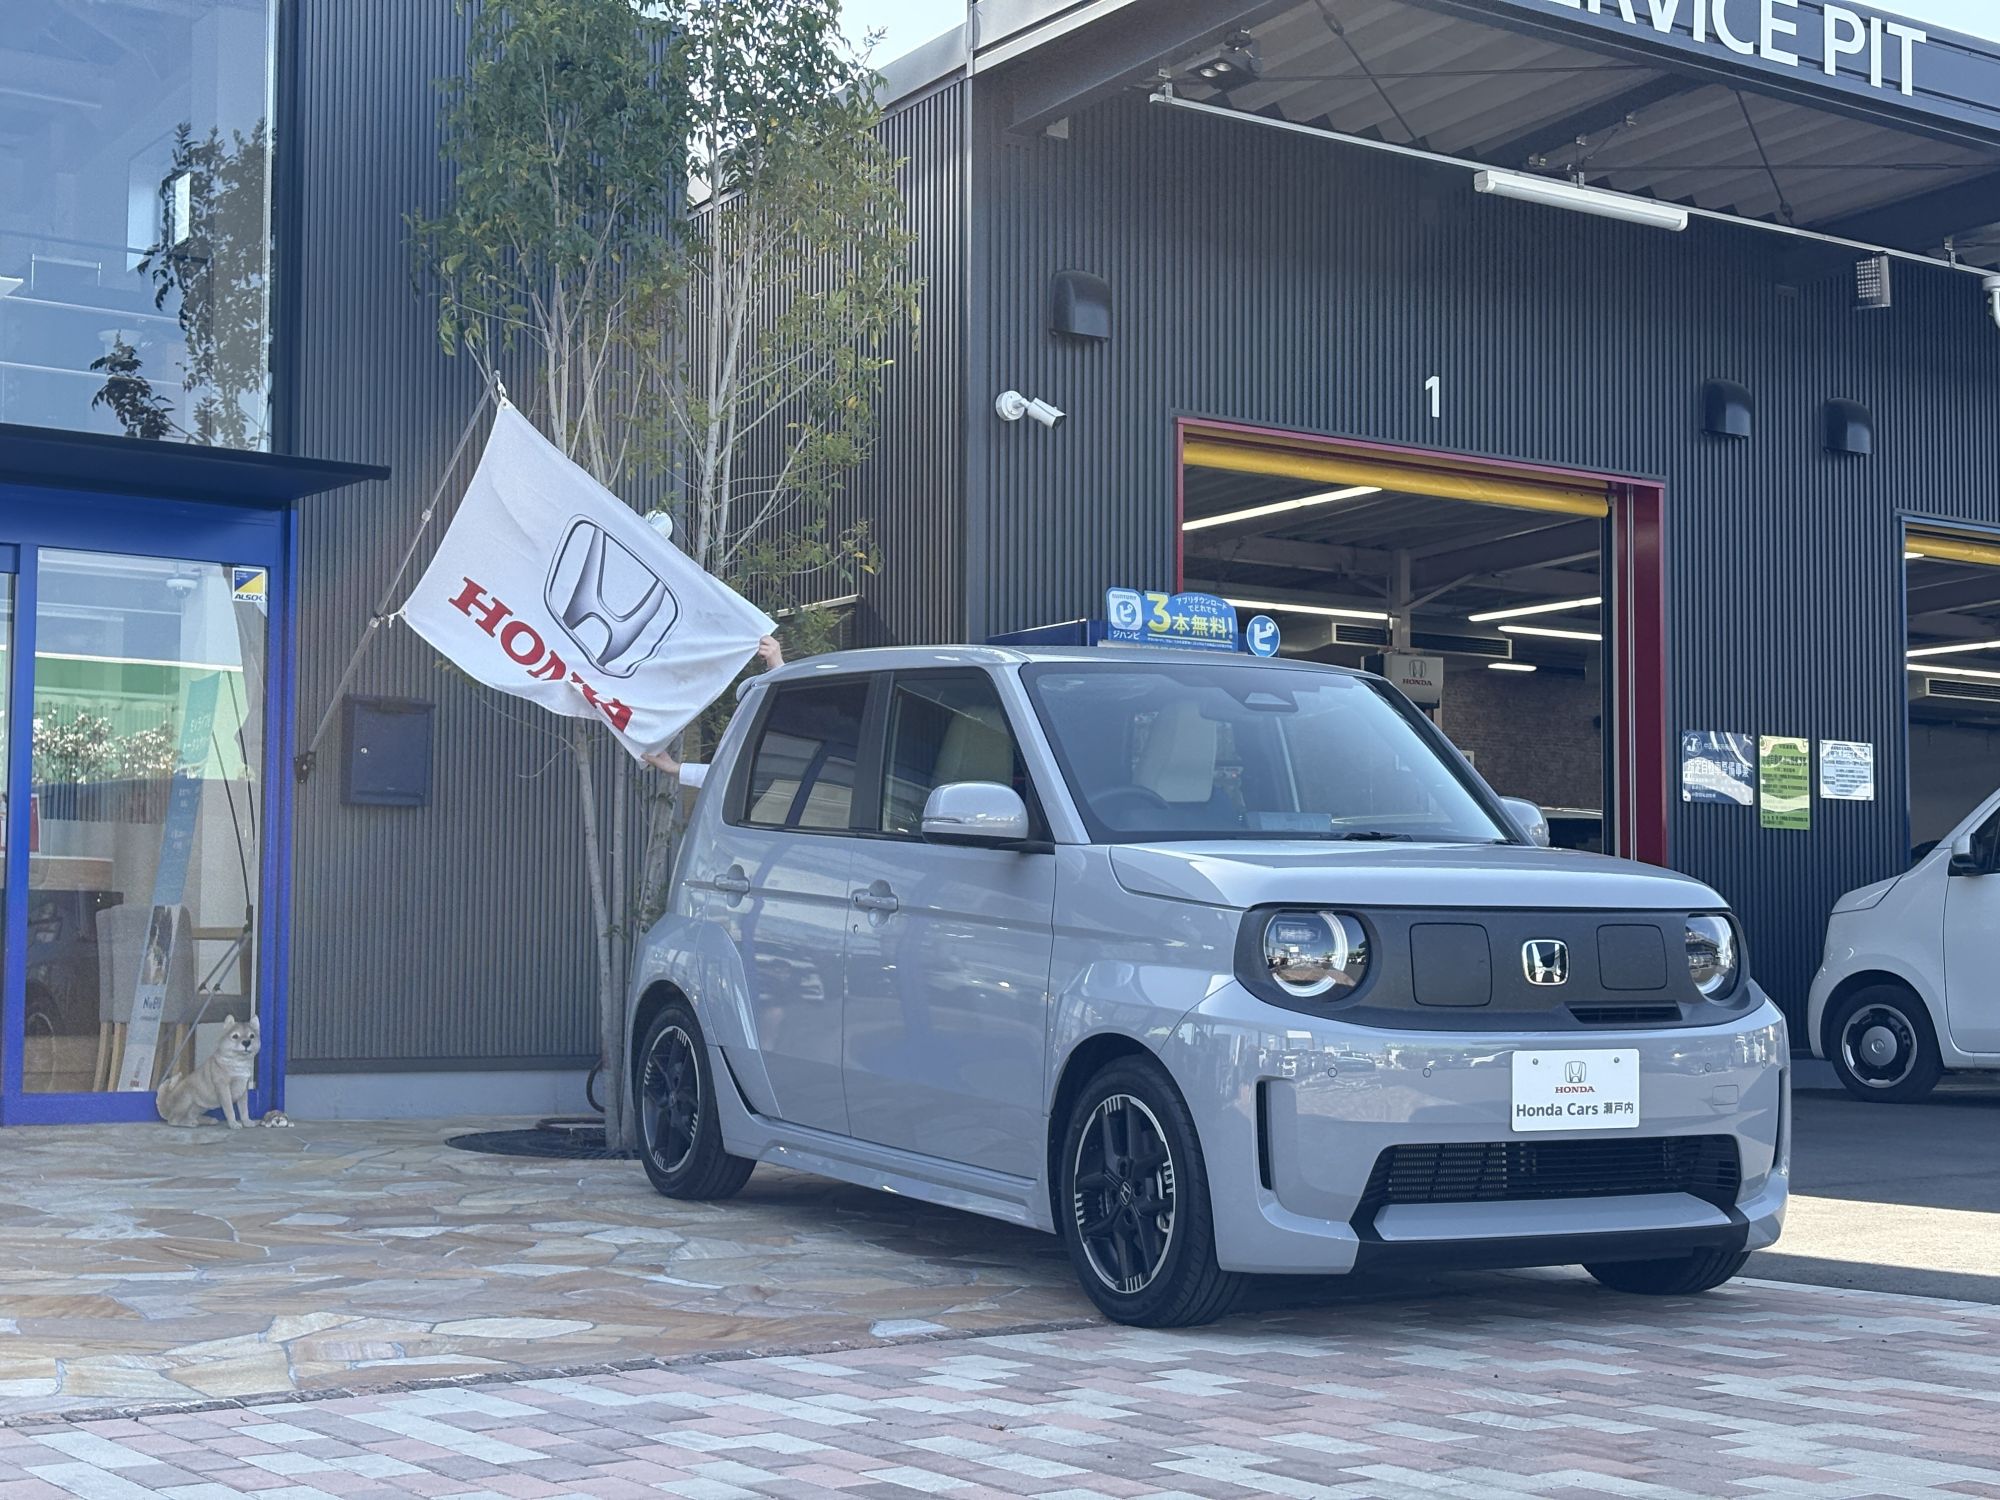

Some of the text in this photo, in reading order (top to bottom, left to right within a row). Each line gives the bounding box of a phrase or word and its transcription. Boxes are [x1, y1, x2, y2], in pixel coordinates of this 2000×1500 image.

[1823, 3, 1927, 97] PIT
[1425, 375, 1440, 418] 1
[234, 593, 264, 602] ALSOK
[1516, 1101, 1634, 1117] Honda Cars 瀬戸内
